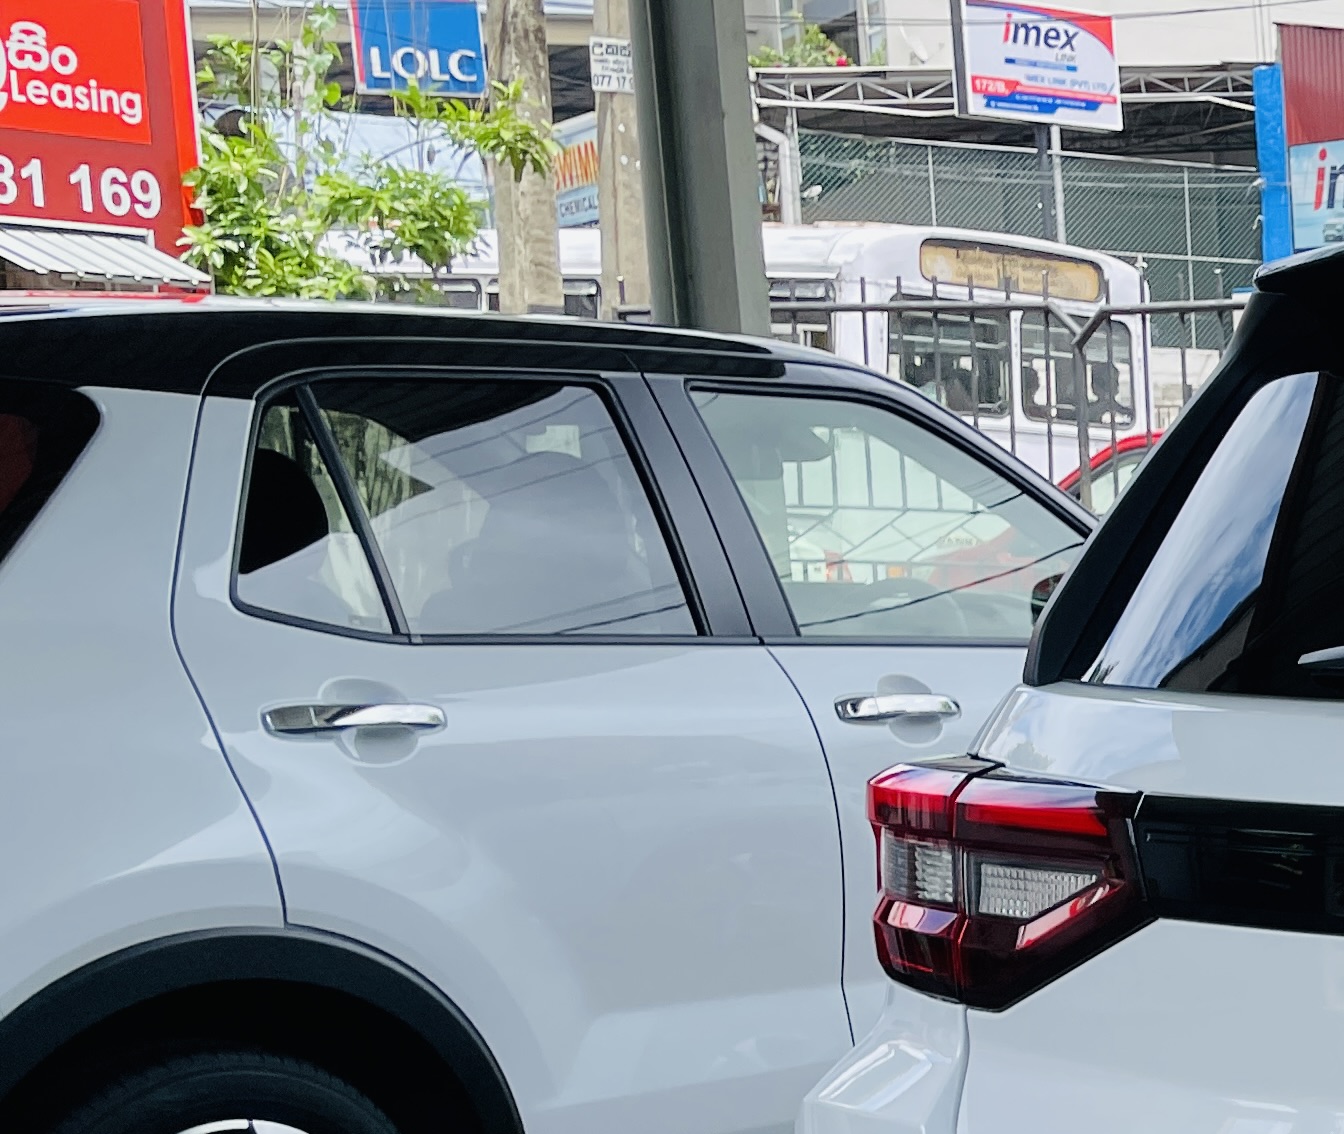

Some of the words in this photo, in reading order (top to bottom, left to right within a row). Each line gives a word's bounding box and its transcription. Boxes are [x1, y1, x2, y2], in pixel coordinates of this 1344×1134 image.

[1003, 13, 1079, 51] imex
[370, 46, 477, 82] LOLC
[9, 69, 142, 125] Leasing
[69, 163, 161, 219] 169
